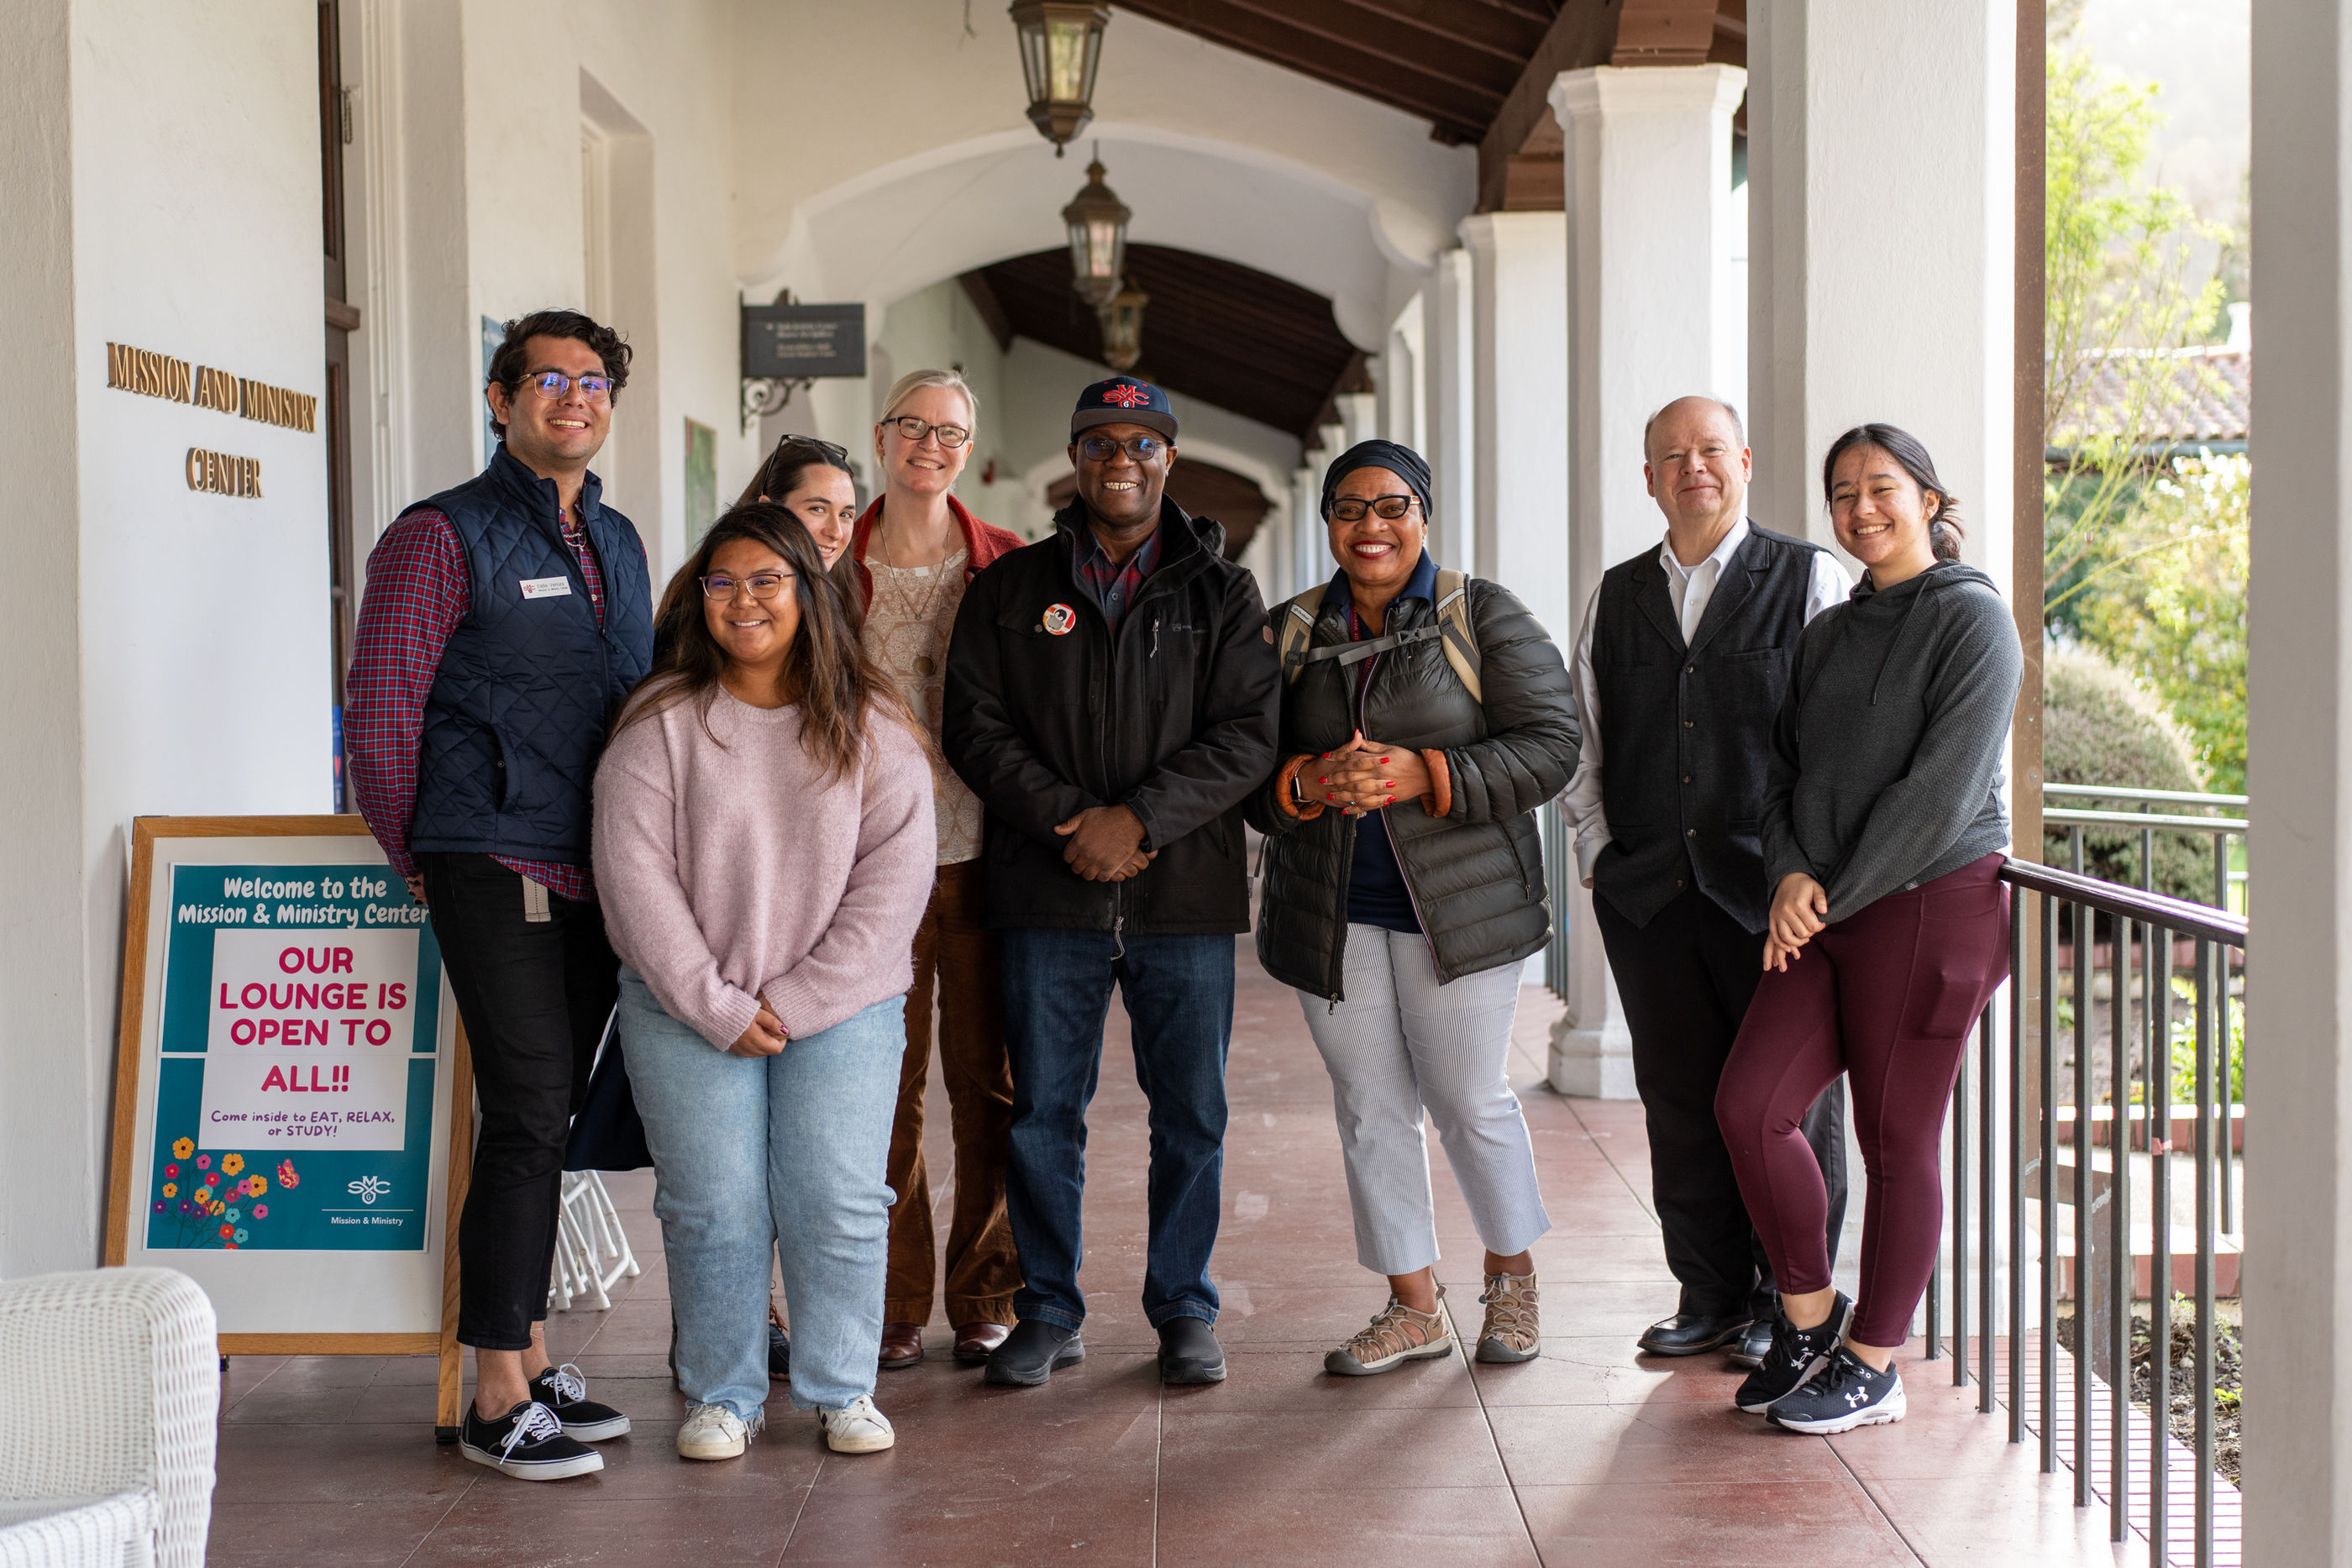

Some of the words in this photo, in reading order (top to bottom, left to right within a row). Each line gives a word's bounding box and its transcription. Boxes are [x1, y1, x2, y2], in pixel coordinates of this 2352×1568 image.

[106, 342, 192, 404] MISSION
[192, 365, 240, 414] AND
[239, 377, 318, 433] MINISTRY
[186, 447, 265, 498] CENTER
[223, 876, 315, 899] Welcome
[320, 876, 344, 899] to
[349, 875, 387, 898] the
[178, 903, 247, 924] Mission
[253, 903, 270, 925] &
[276, 904, 359, 929] Ministry
[365, 903, 429, 924] Center
[279, 947, 354, 974] OUR
[219, 983, 367, 1010] LOUNGE
[378, 982, 407, 1010] IS
[230, 1018, 333, 1046] OPEN
[340, 1018, 391, 1046] TO
[261, 1064, 350, 1093] ALL!!
[211, 1109, 248, 1122] Come
[252, 1111, 288, 1122] inside
[293, 1111, 306, 1122] to
[310, 1111, 343, 1124] EAT,
[346, 1110, 395, 1124] RELAX,
[268, 1127, 281, 1136] or
[286, 1125, 338, 1137] STUDY!
[331, 1216, 360, 1225] Mission
[371, 1216, 404, 1226] Ministry
